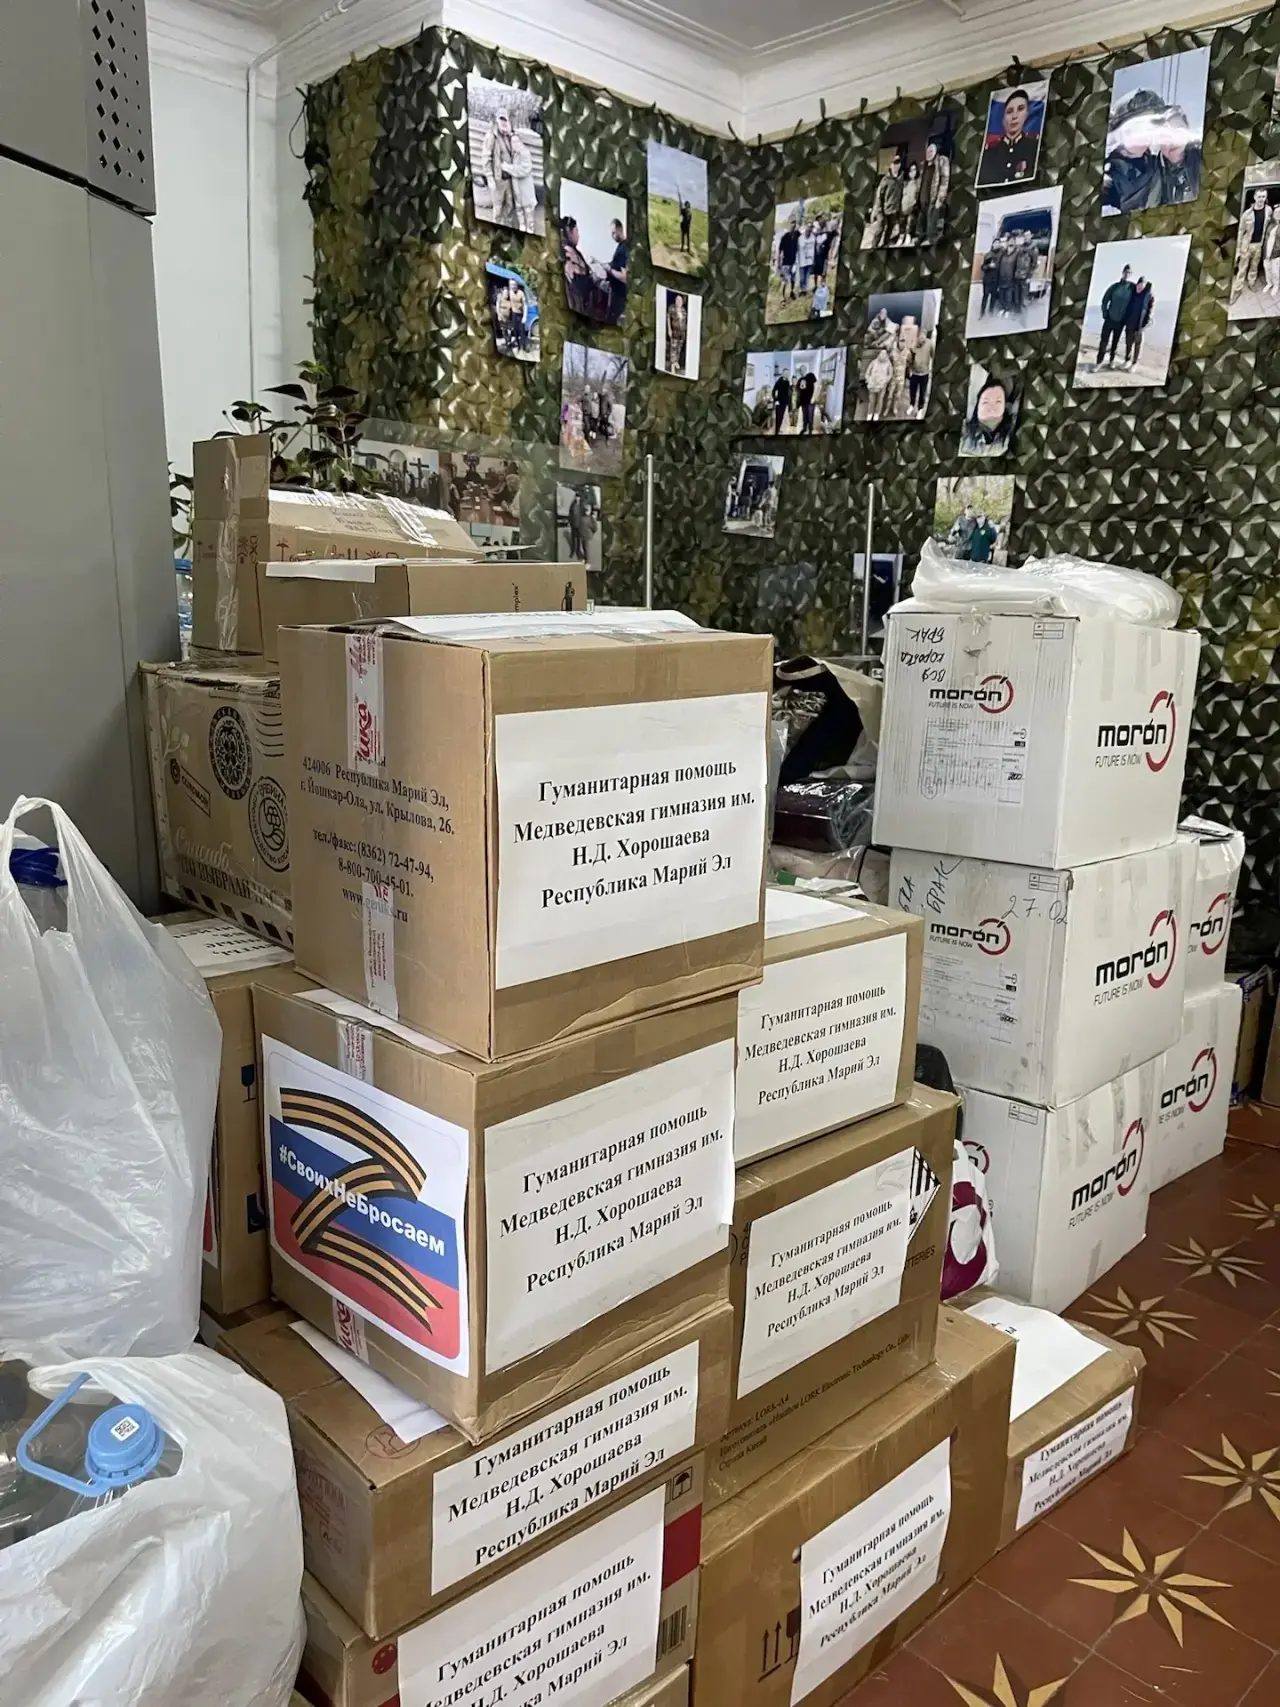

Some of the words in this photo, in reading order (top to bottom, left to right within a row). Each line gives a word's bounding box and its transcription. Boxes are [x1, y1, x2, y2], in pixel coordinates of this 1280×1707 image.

[906, 627, 944, 644] БРАК
[1095, 755, 1119, 768] FUTURE
[1120, 755, 1128, 766] IS
[1128, 753, 1143, 766] NOW
[1097, 718, 1167, 748] morón
[302, 756, 331, 776] 424006
[335, 764, 390, 793] Республика
[392, 778, 428, 803] Марий
[430, 788, 449, 811] Эл,
[538, 768, 669, 805] Гуманитарная
[675, 761, 737, 782] помощь
[369, 800, 384, 815] ул.
[386, 801, 436, 832] Крылова,
[438, 816, 455, 835] 26.
[513, 811, 645, 843] Медведевская
[650, 797, 725, 820] гимназия
[731, 791, 755, 807] им.
[388, 851, 434, 883] 72-47-94,
[572, 843, 611, 867] Н.Д.
[616, 829, 710, 859] Хорошаева
[541, 875, 647, 908] Республика
[652, 860, 707, 886] Марий
[712, 855, 731, 872] Эл
[1187, 944, 1198, 955] OW
[1190, 915, 1224, 937] rón
[1095, 937, 1169, 986] morón
[761, 998, 843, 1031] Гуманитарная
[846, 985, 886, 1005] помощь
[1094, 988, 1119, 1007] FUTURE
[1120, 984, 1128, 997] IS
[1129, 977, 1143, 994] NOW
[744, 1027, 826, 1061] Медведевская
[829, 1013, 878, 1035] гимназия
[880, 1006, 897, 1019] им.
[778, 1055, 803, 1074] Н.Д.
[806, 1037, 867, 1064] Хорошаева
[757, 1074, 824, 1105] Республика
[827, 1059, 863, 1082] Марий
[866, 1054, 880, 1069] Эл
[1160, 1070, 1209, 1109] orón
[522, 1132, 645, 1193] Гуманитарная
[650, 1106, 707, 1140] помощь
[279, 1145, 445, 1256] #СвоихНеБросаем
[499, 1175, 622, 1238] Медведевская
[627, 1139, 697, 1182] гимназия
[701, 1130, 723, 1148] им.
[1071, 1148, 1137, 1211] morón
[555, 1217, 591, 1245] Н.Д.
[596, 1175, 682, 1227] Хорошаева
[770, 1220, 850, 1268] Гуманитарная
[853, 1201, 893, 1225] помощь
[1068, 1206, 1093, 1230] FUTURE
[1094, 1202, 1100, 1215] IS
[1101, 1193, 1115, 1209] NOW
[526, 1238, 624, 1292] Республика
[629, 1206, 680, 1243] Марий
[684, 1196, 703, 1215] Эл
[754, 1252, 834, 1300] Медведевская
[836, 1225, 884, 1258] гимназия
[886, 1218, 902, 1233] им.
[767, 1293, 831, 1337] Республика
[833, 1272, 869, 1301] Марий
[871, 1264, 884, 1280] Эл
[787, 1283, 811, 1304] Н.Д.
[813, 1252, 872, 1290] Хорошаева
[473, 1401, 603, 1477] Гуманитарная
[609, 1363, 670, 1408] помощь
[447, 1445, 578, 1522] Медведевская
[584, 1401, 658, 1447] гимназия
[664, 1388, 688, 1409] им.
[505, 1485, 544, 1519] Н.Д.
[549, 1434, 642, 1495] Хорошаева
[474, 1498, 578, 1566] Республика
[584, 1460, 639, 1499] Марий
[644, 1447, 664, 1468] Эл
[809, 1556, 882, 1618] Медведевская
[885, 1523, 928, 1561] гимназия
[930, 1510, 945, 1525] им.
[822, 1518, 896, 1584] Гуманитарная
[898, 1494, 934, 1528] помощь
[437, 1595, 567, 1682] Гуманитарная
[572, 1556, 634, 1600] помощь
[547, 1588, 622, 1643] гимназия
[627, 1574, 651, 1592] им.
[821, 1595, 879, 1647] Республика
[470, 1683, 508, 1707] Н.Д.
[513, 1625, 605, 1691] Хорошаева
[547, 1652, 602, 1696] Марий
[607, 1635, 627, 1658] Эл
